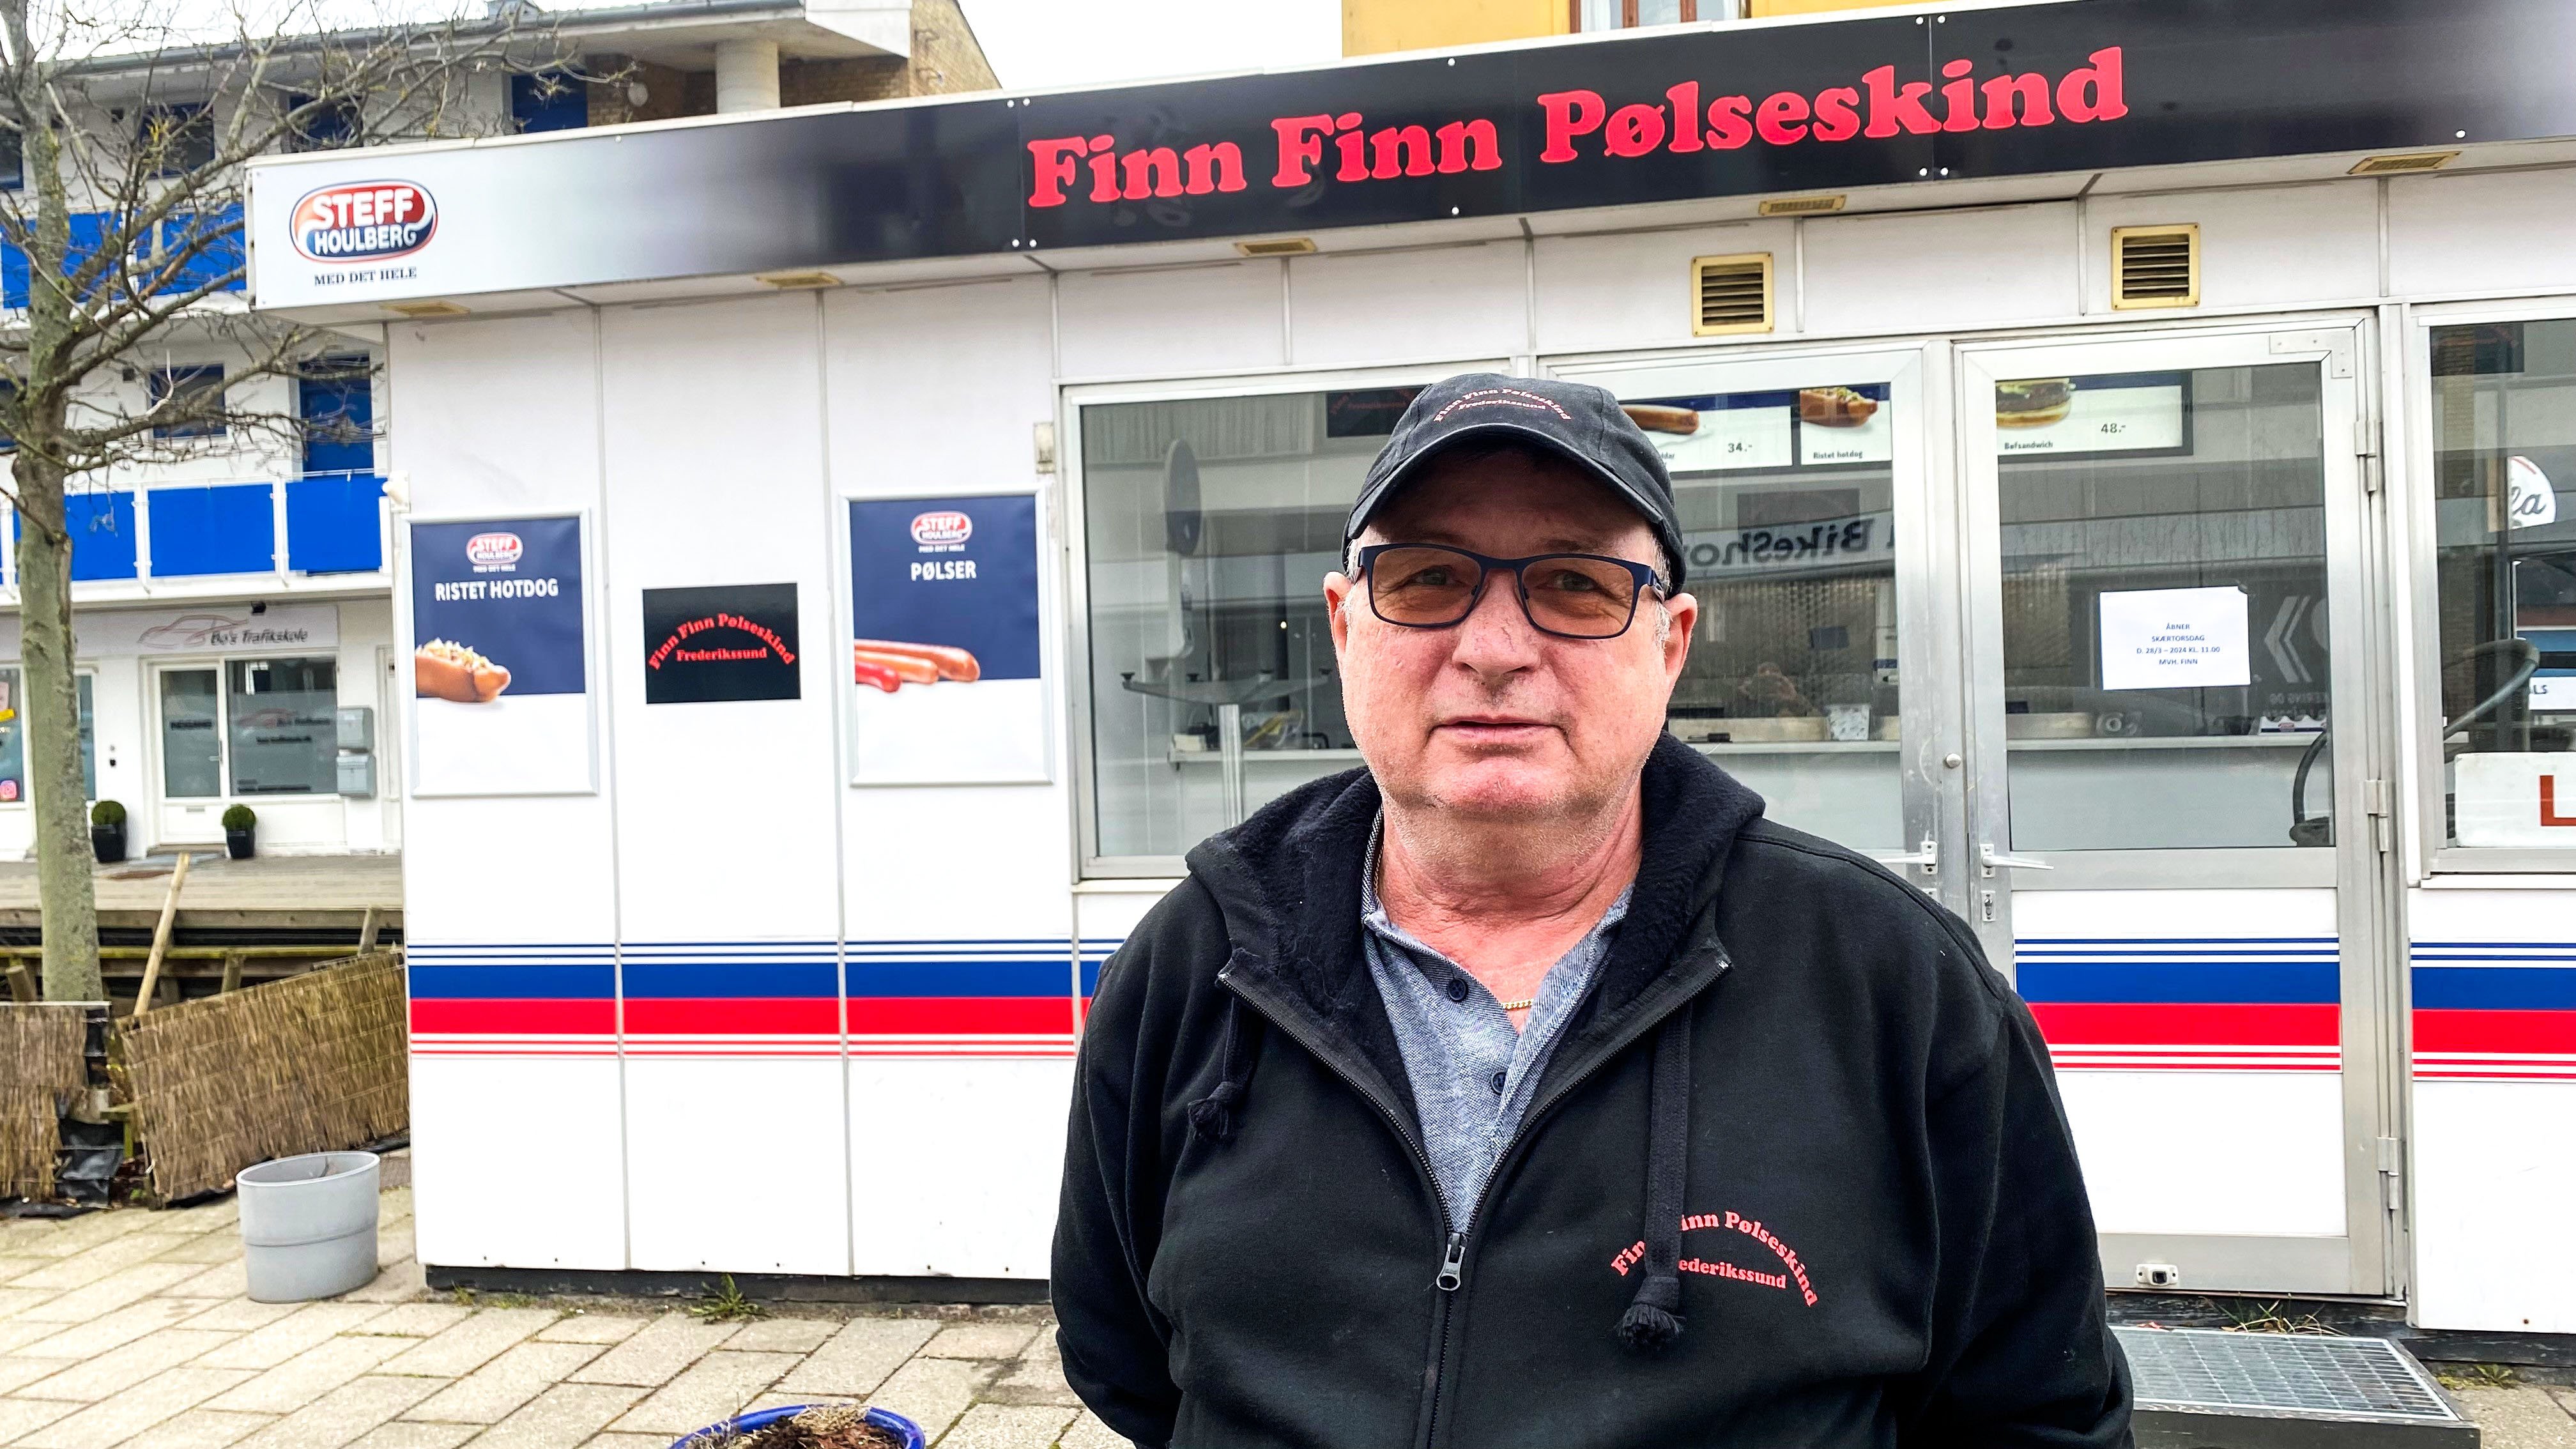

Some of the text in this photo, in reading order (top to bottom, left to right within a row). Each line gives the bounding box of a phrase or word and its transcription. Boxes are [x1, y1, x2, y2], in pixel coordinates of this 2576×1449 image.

[1027, 46, 2129, 208] Finn Finn Pølseskind
[312, 187, 414, 230] STEFF
[314, 224, 417, 255] HOULBERG
[314, 266, 417, 286] MED DET HELE
[1433, 399, 1463, 422] Finn
[1462, 388, 1499, 401] Finn
[2101, 422, 2126, 433] 48.-
[1727, 441, 1752, 453] 34.-
[1813, 449, 1863, 459] Ristet hotdog
[920, 516, 962, 532] STEFF
[910, 560, 977, 581] PØLSER
[434, 578, 559, 601] RISTET HOTDOG
[648, 612, 795, 670] Finn Finn Pølseskind
[676, 647, 767, 661] Frederikssund
[1611, 1211, 1818, 1308] Fin inn Pølseskind
[1678, 1257, 1787, 1289] ederikssund
